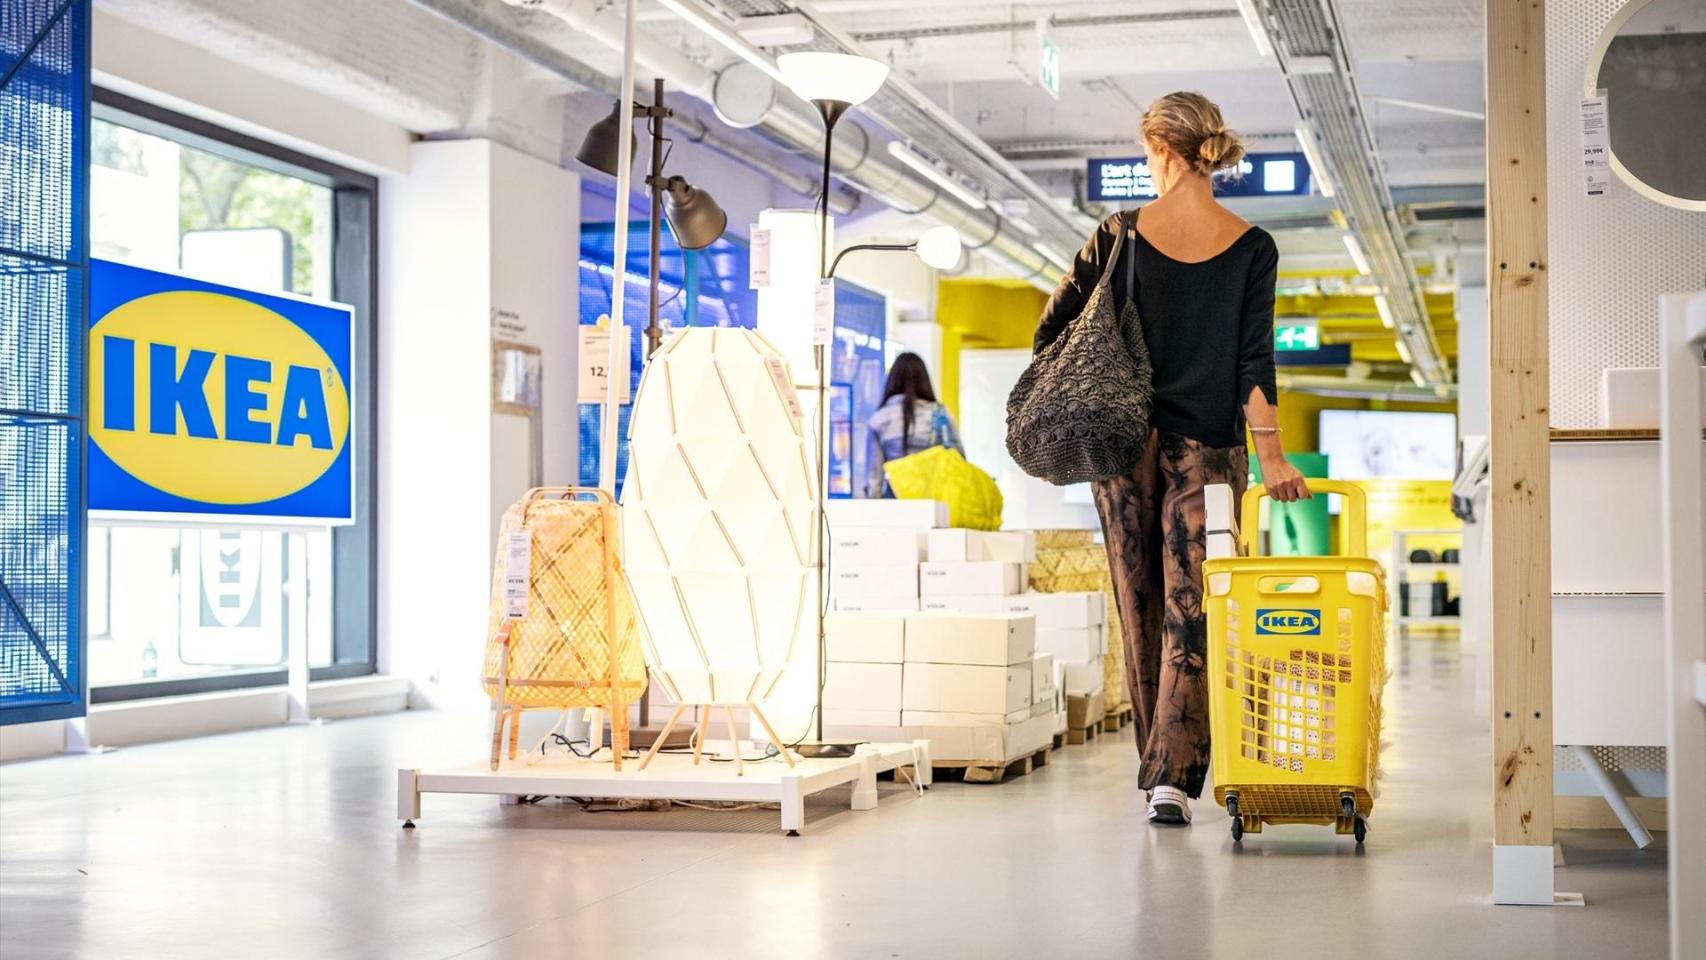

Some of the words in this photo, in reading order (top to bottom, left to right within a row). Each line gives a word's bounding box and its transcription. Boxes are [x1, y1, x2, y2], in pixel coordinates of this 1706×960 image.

[590, 366, 608, 378] 12,
[103, 334, 334, 451] IKEA
[1263, 616, 1314, 627] IKEA
